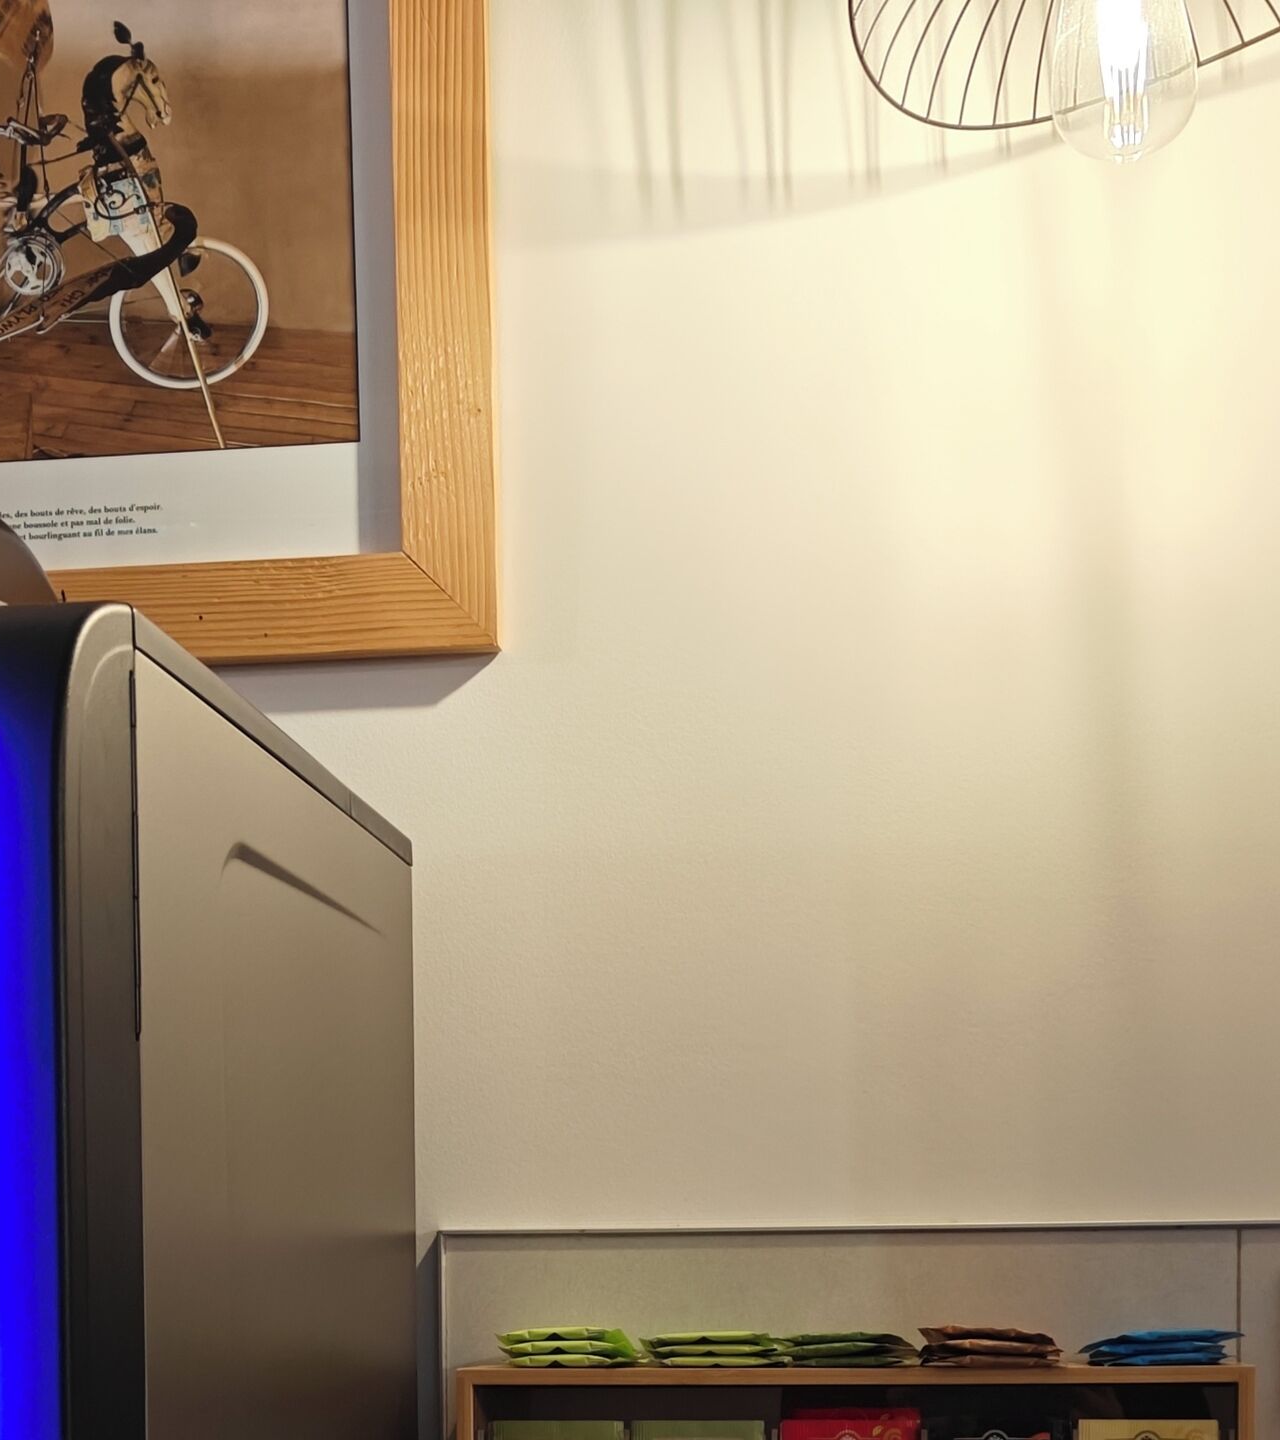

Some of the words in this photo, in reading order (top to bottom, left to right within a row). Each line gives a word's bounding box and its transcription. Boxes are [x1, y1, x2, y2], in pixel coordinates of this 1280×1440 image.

[14, 510, 28, 518] des
[30, 509, 53, 517] bouts
[55, 508, 65, 516] de
[88, 506, 102, 514] des
[104, 504, 126, 513] bouts
[23, 520, 58, 529] boussole
[60, 520, 68, 528] et
[70, 519, 84, 529] pas
[86, 517, 101, 526] mal
[103, 516, 113, 525] de
[115, 515, 135, 525] folie.
[29, 530, 81, 541] bourlinguant
[82, 530, 92, 538] au
[94, 528, 104, 537] fil
[105, 528, 115, 536] de
